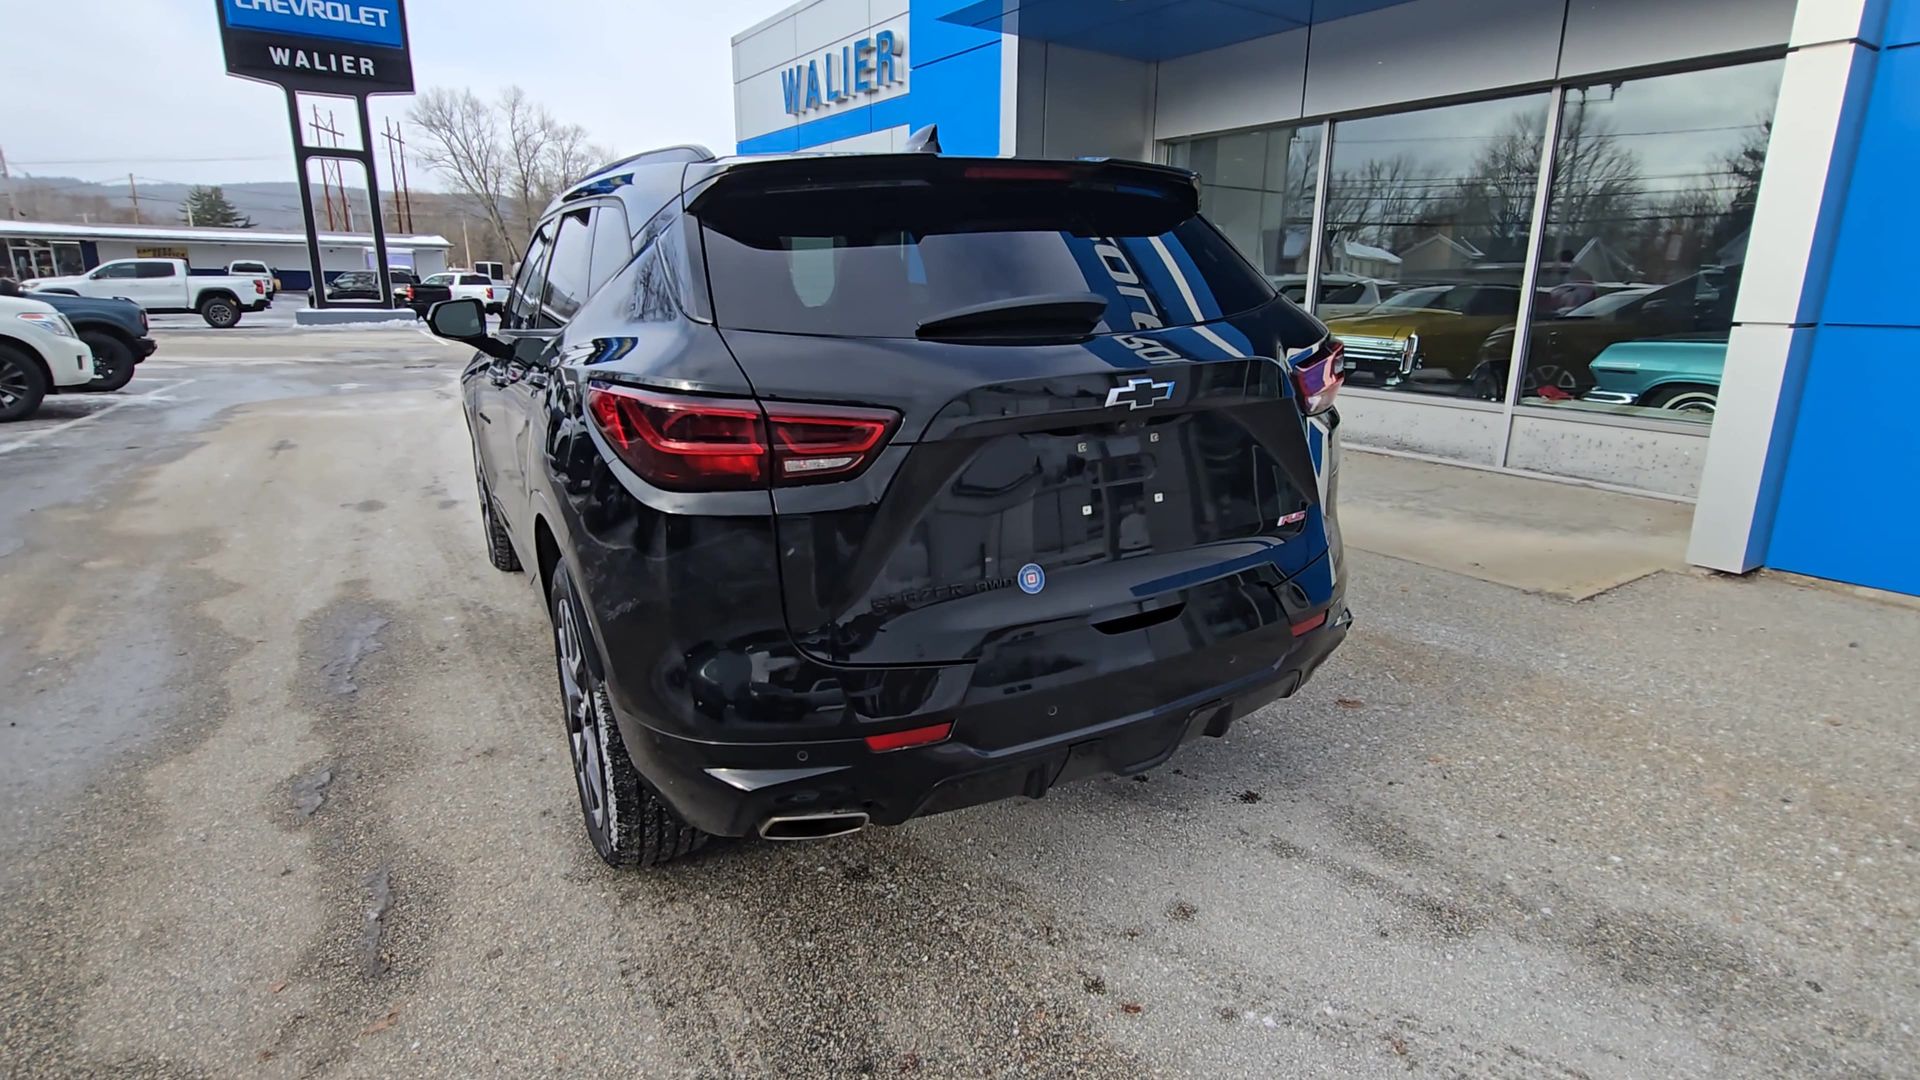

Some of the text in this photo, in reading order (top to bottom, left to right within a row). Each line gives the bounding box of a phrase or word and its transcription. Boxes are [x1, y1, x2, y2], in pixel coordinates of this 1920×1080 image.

[268, 46, 375, 76] WALIER
[781, 30, 899, 115] WALIER
[1277, 511, 1306, 527] RS
